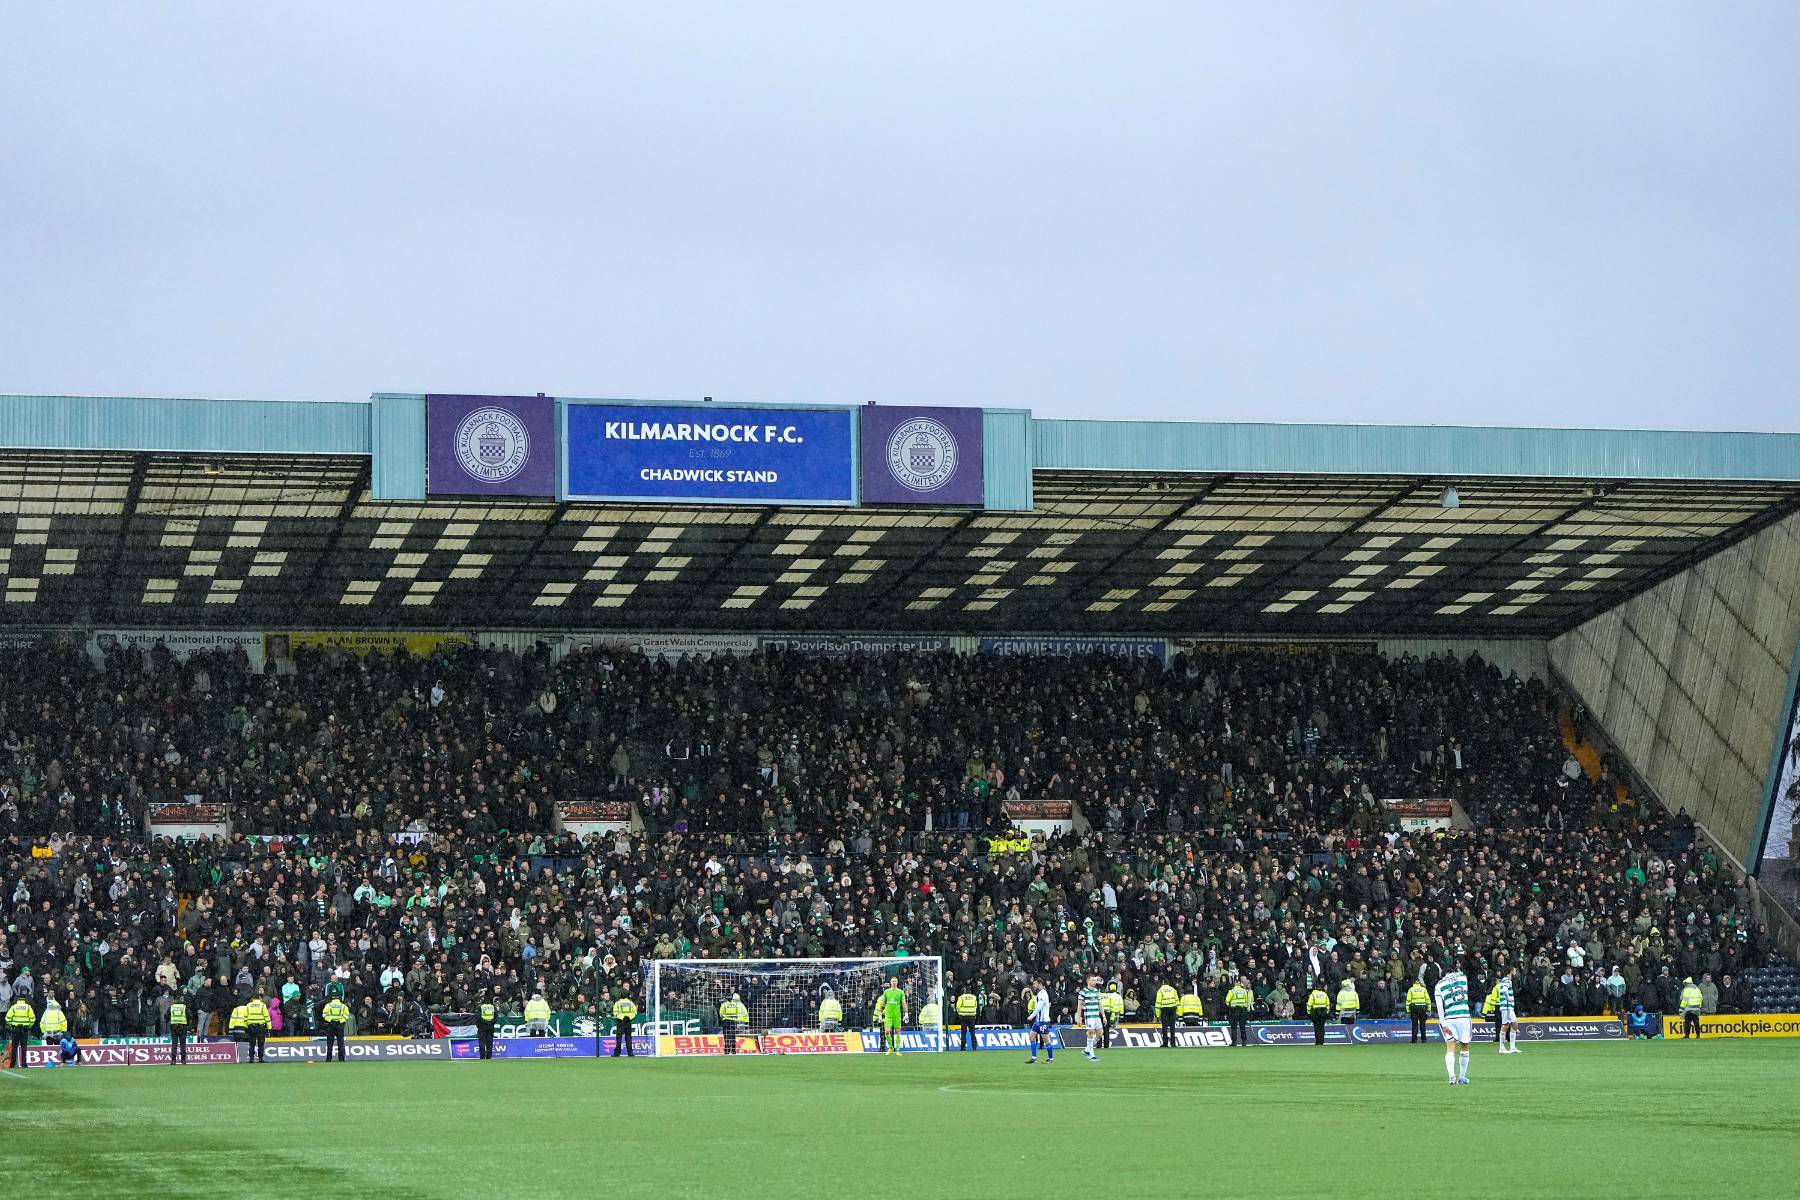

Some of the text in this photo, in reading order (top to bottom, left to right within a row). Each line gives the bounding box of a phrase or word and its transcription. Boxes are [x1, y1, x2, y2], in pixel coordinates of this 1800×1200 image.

[461, 413, 524, 465] THE KILMARNOCK FOOTBALL CLUB
[605, 422, 804, 443] KILMARNOCK F.C.
[893, 424, 953, 474] THE KILMARNOCK FOOTBALL CLUB
[474, 465, 510, 477] LIMITED
[640, 468, 778, 483] CHADWICK STAND
[906, 473, 939, 486] LIMITED
[121, 634, 261, 645] Portland Janitorial Products
[643, 638, 669, 646] Grant
[697, 638, 753, 647] Commercials
[791, 639, 850, 651] Davidson
[919, 641, 942, 652] LLP
[762, 1034, 846, 1048] BOWIE
[863, 1032, 1058, 1049] HMILTN TARMC
[1266, 1031, 1293, 1041] sprint
[1360, 1031, 1388, 1040] sprint
[386, 1044, 442, 1056] SIGNS
[473, 1044, 507, 1053] FEW
[26, 1047, 150, 1065] BRWN'S
[210, 1053, 231, 1061] LTD
